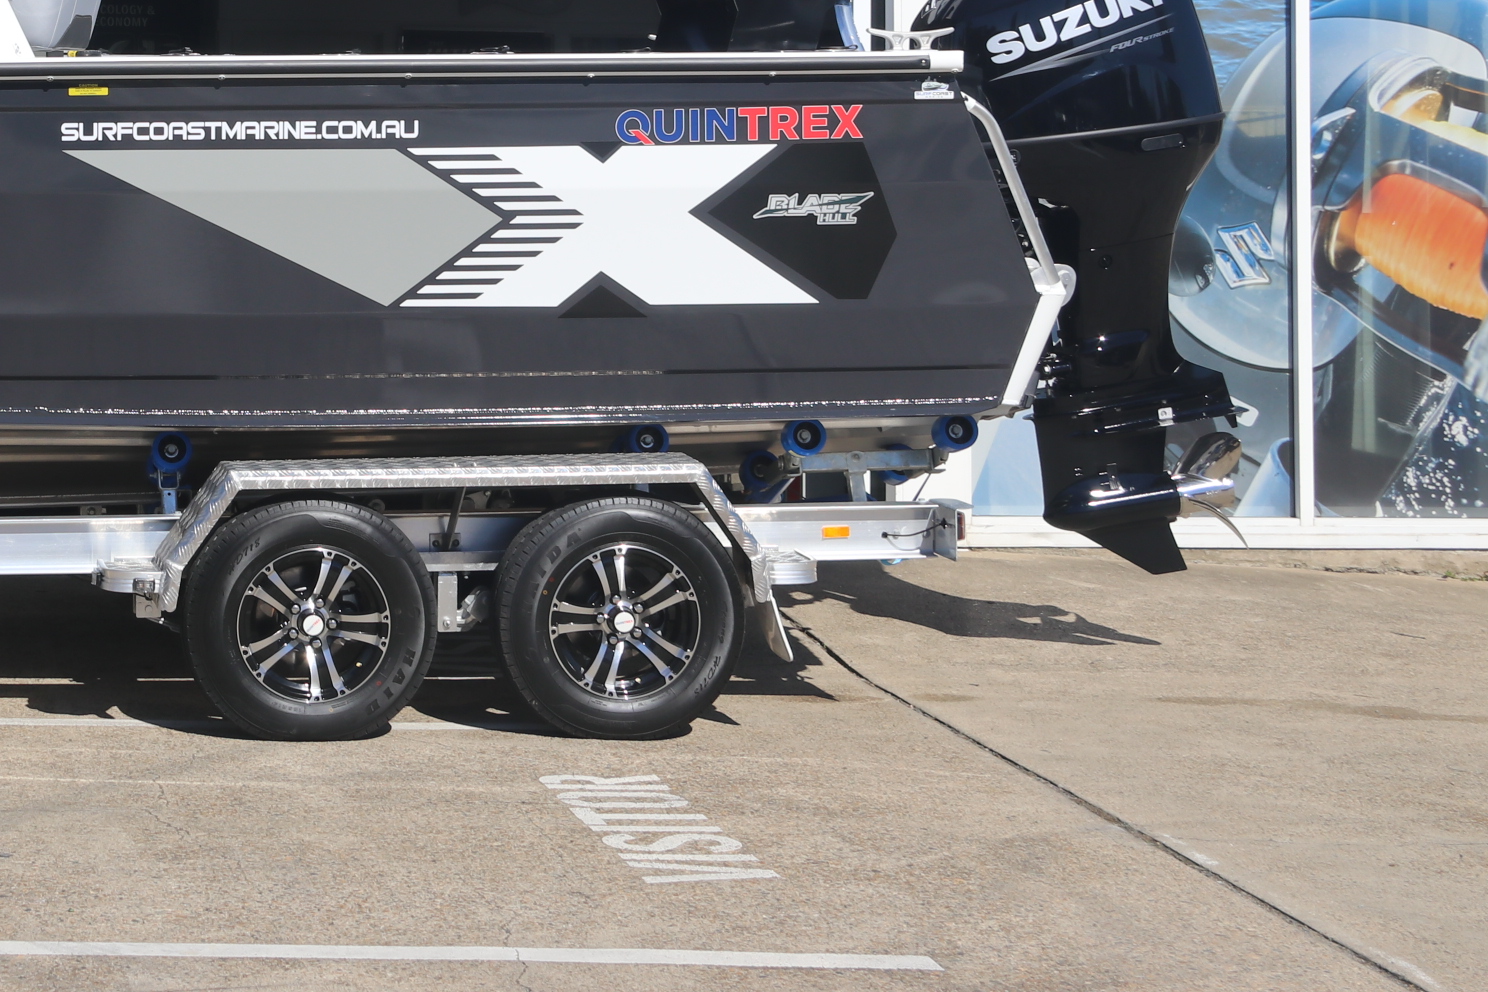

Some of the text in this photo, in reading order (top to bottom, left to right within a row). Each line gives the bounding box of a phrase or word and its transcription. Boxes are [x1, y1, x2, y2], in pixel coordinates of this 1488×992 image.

[99, 5, 143, 15] COLOGY
[60, 119, 420, 142] SURFCOASTMARINE.COM.AU
[615, 104, 864, 145] QUINTREX
[762, 193, 868, 216] BLADE
[819, 212, 854, 222] HULL
[538, 764, 785, 884] VISITOR
